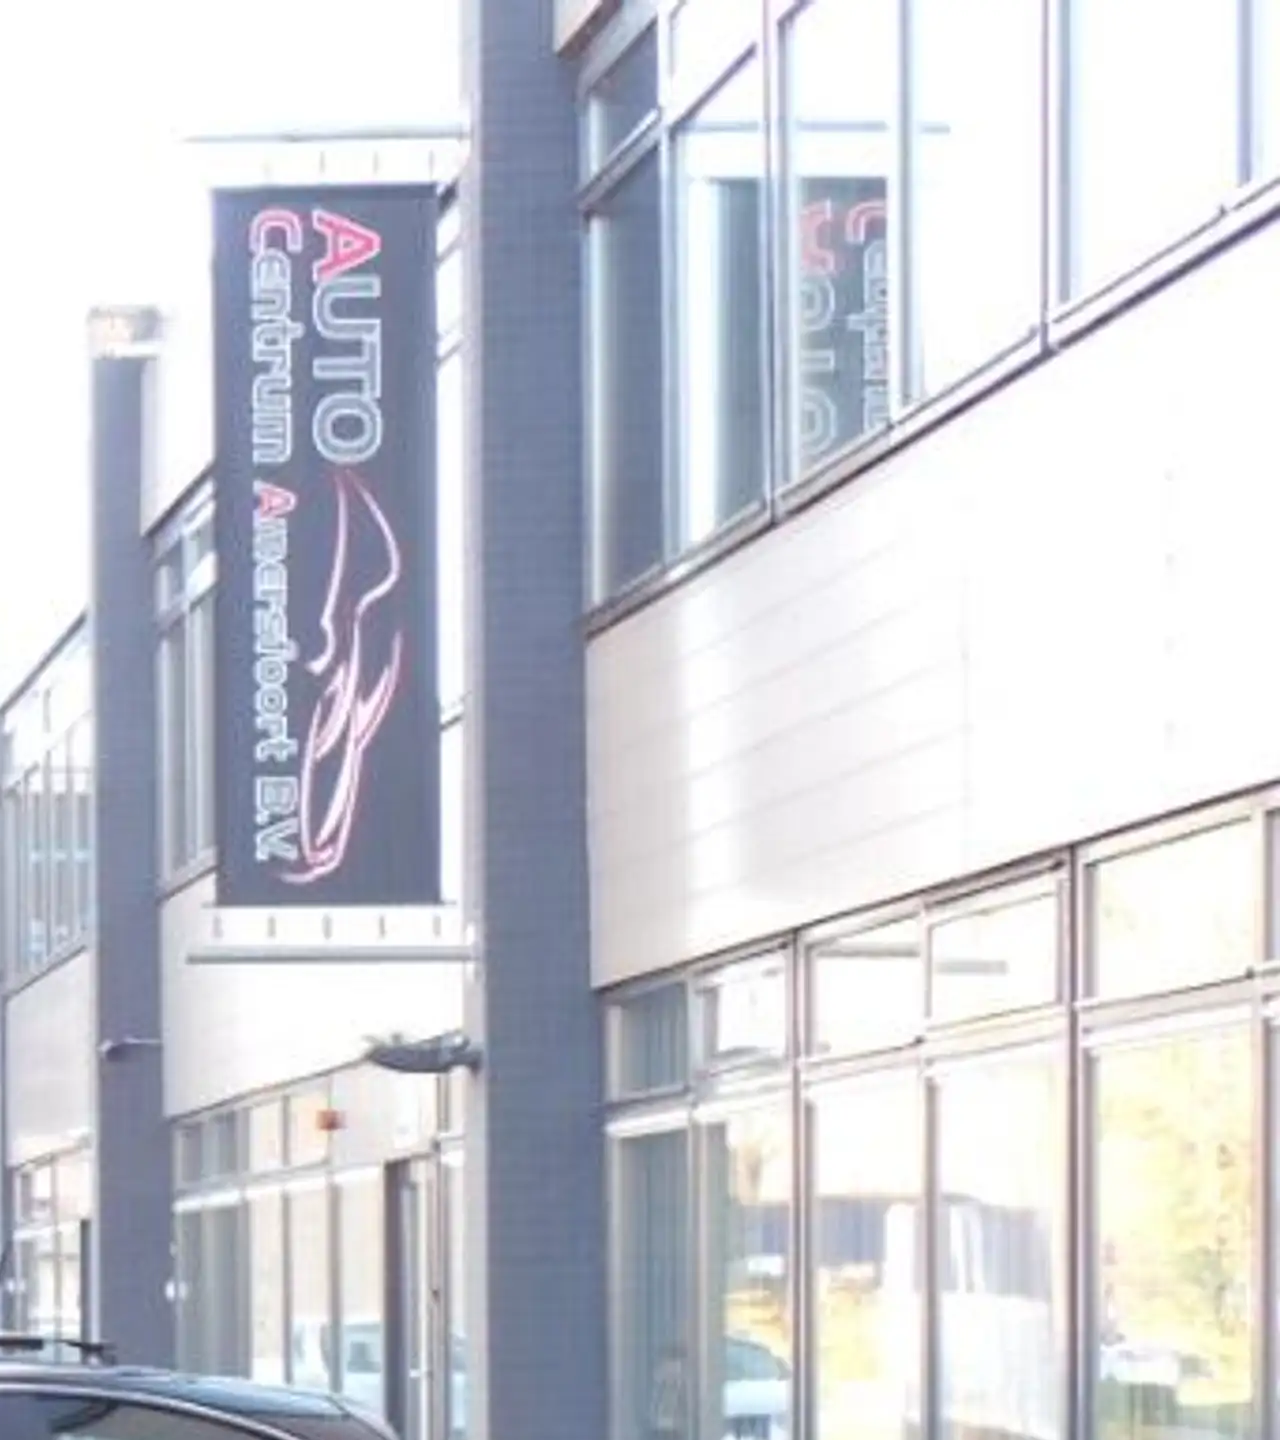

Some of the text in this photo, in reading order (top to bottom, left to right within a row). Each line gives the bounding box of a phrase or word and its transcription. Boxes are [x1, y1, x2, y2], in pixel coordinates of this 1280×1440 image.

[249, 208, 304, 463] Centrum
[313, 207, 383, 464] AUTO
[253, 480, 300, 762] Amersfoort
